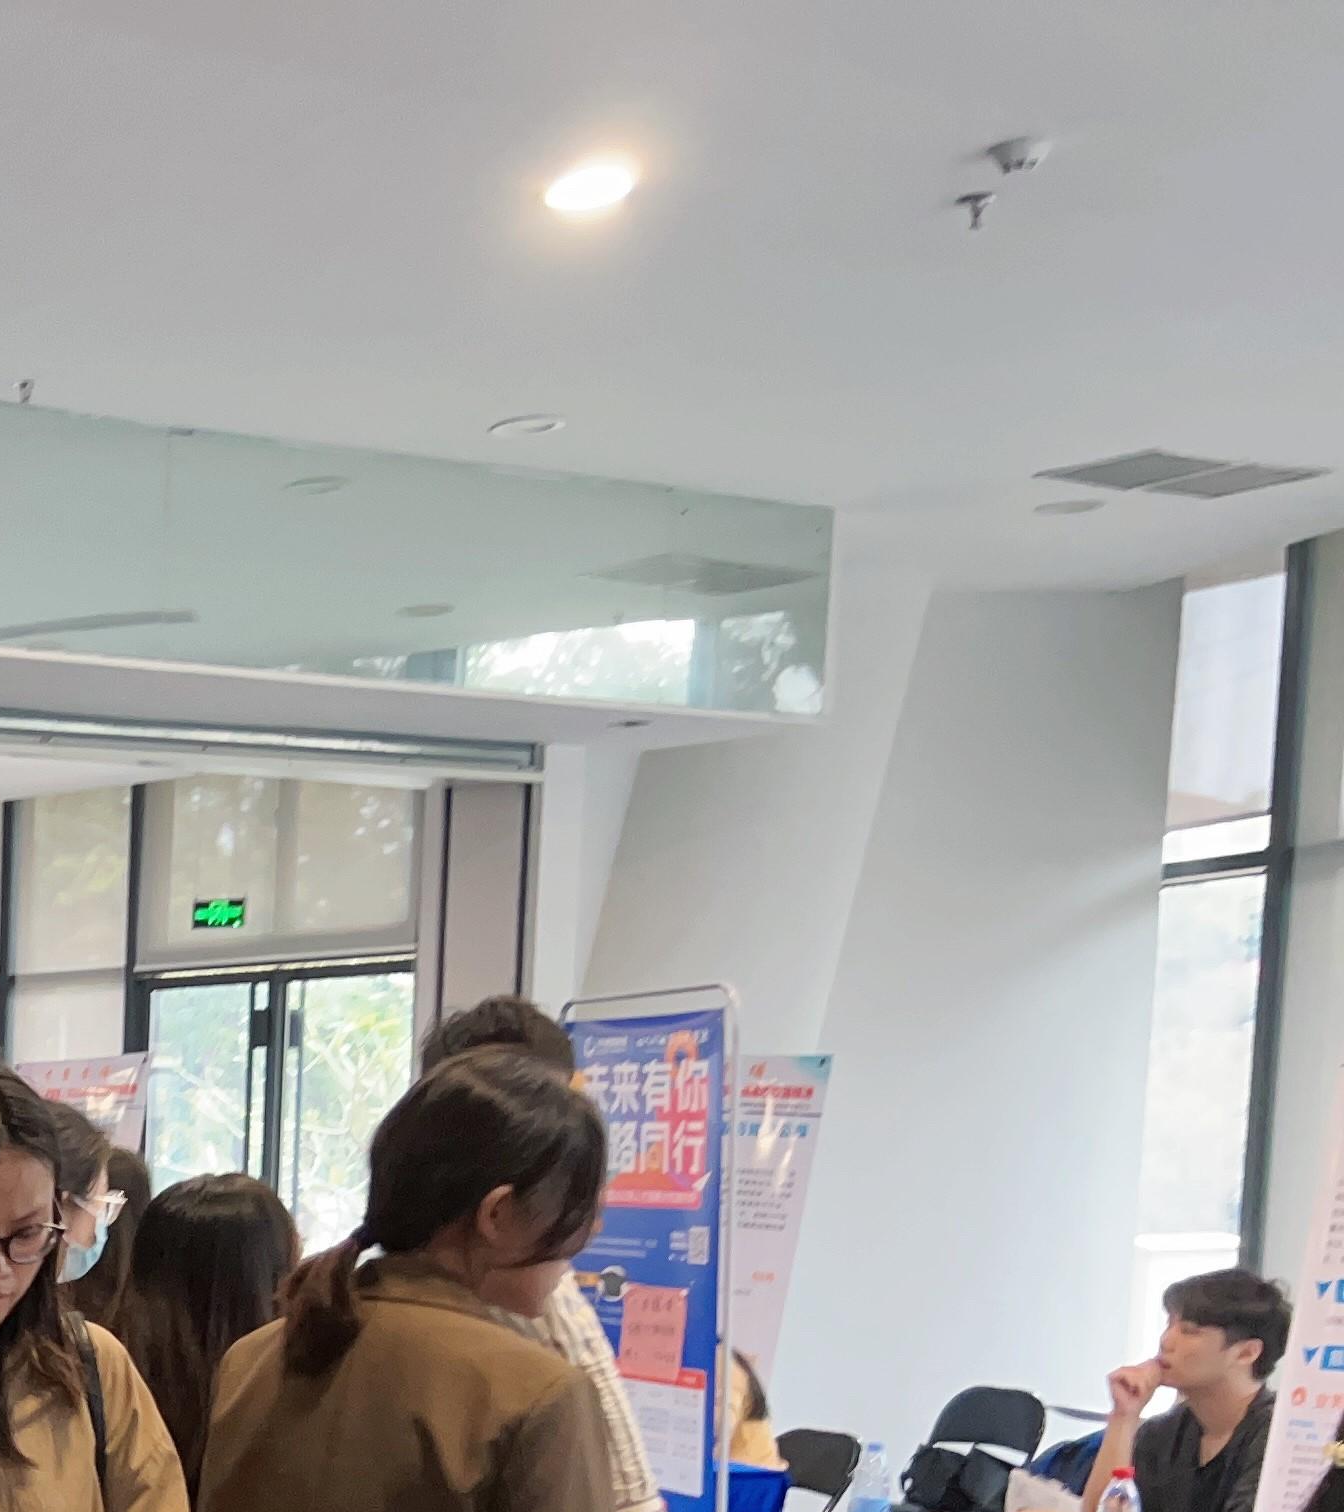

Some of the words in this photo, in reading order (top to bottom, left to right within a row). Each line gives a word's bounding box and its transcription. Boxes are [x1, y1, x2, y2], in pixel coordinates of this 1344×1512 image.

[581, 1057, 710, 1114] 未来有你
[607, 1119, 706, 1175] 路同行
